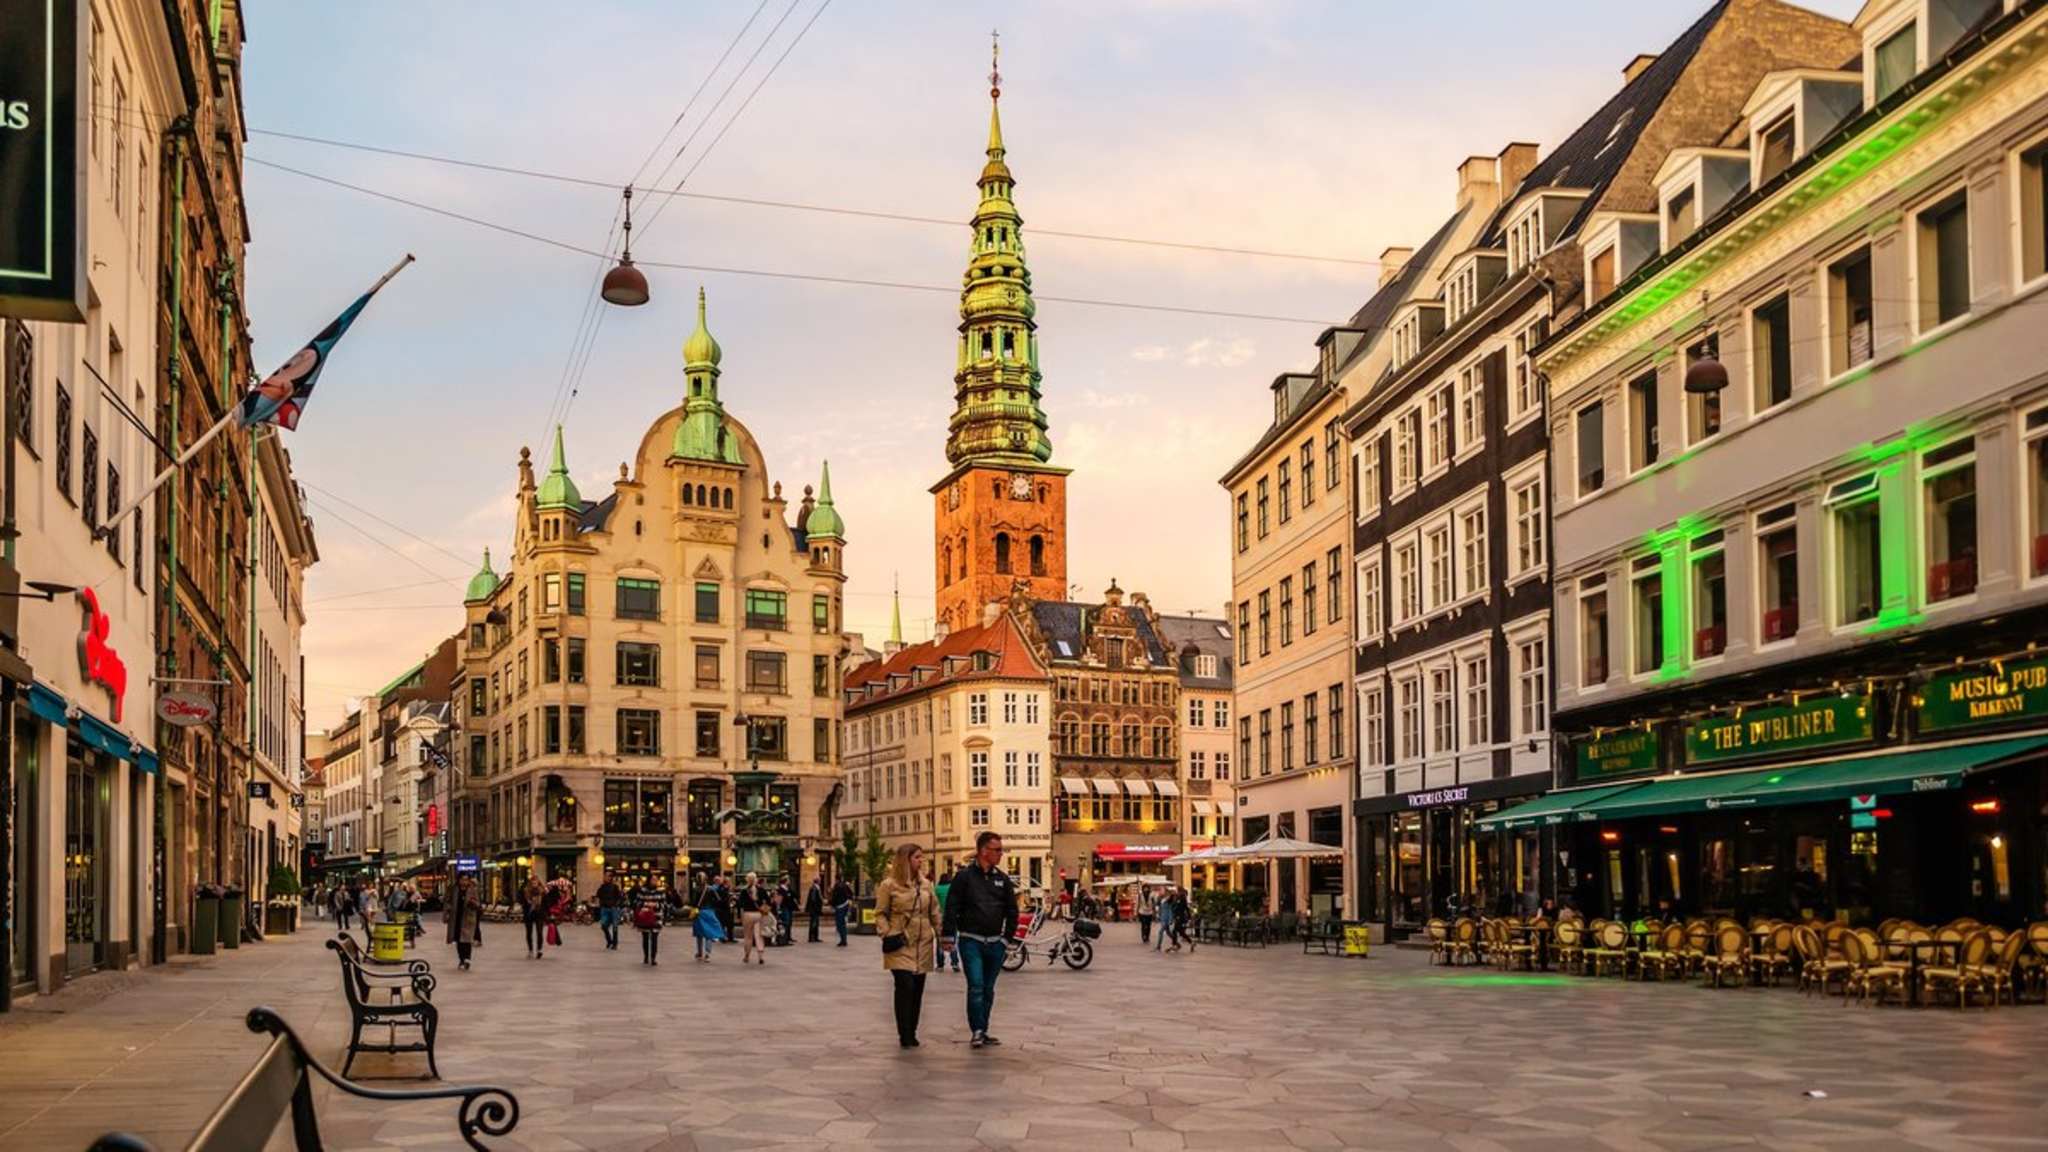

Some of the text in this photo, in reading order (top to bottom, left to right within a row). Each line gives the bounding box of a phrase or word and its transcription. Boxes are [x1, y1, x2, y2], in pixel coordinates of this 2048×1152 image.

[1950, 666, 2047, 701] MUSIC PUB
[163, 698, 210, 720] Disney
[1969, 694, 2024, 719] KILKENNY
[1713, 709, 1835, 750] THE DUBLINER
[1443, 787, 1468, 803] SECRET
